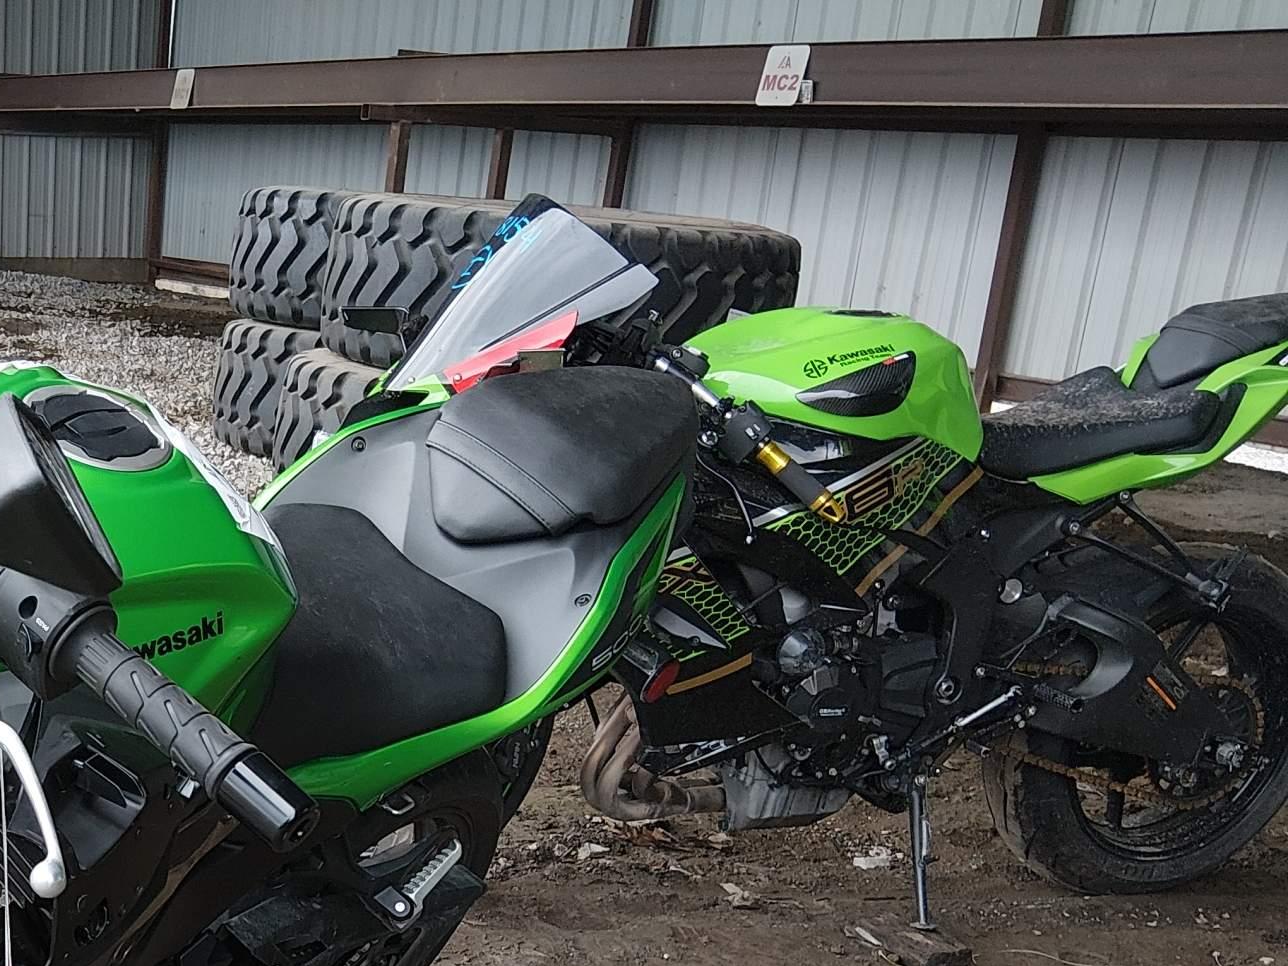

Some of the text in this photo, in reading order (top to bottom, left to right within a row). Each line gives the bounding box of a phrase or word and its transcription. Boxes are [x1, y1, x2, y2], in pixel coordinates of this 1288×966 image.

[762, 75, 799, 91] MC2
[826, 344, 896, 365] Kawasaki
[132, 610, 224, 660] wasaki
